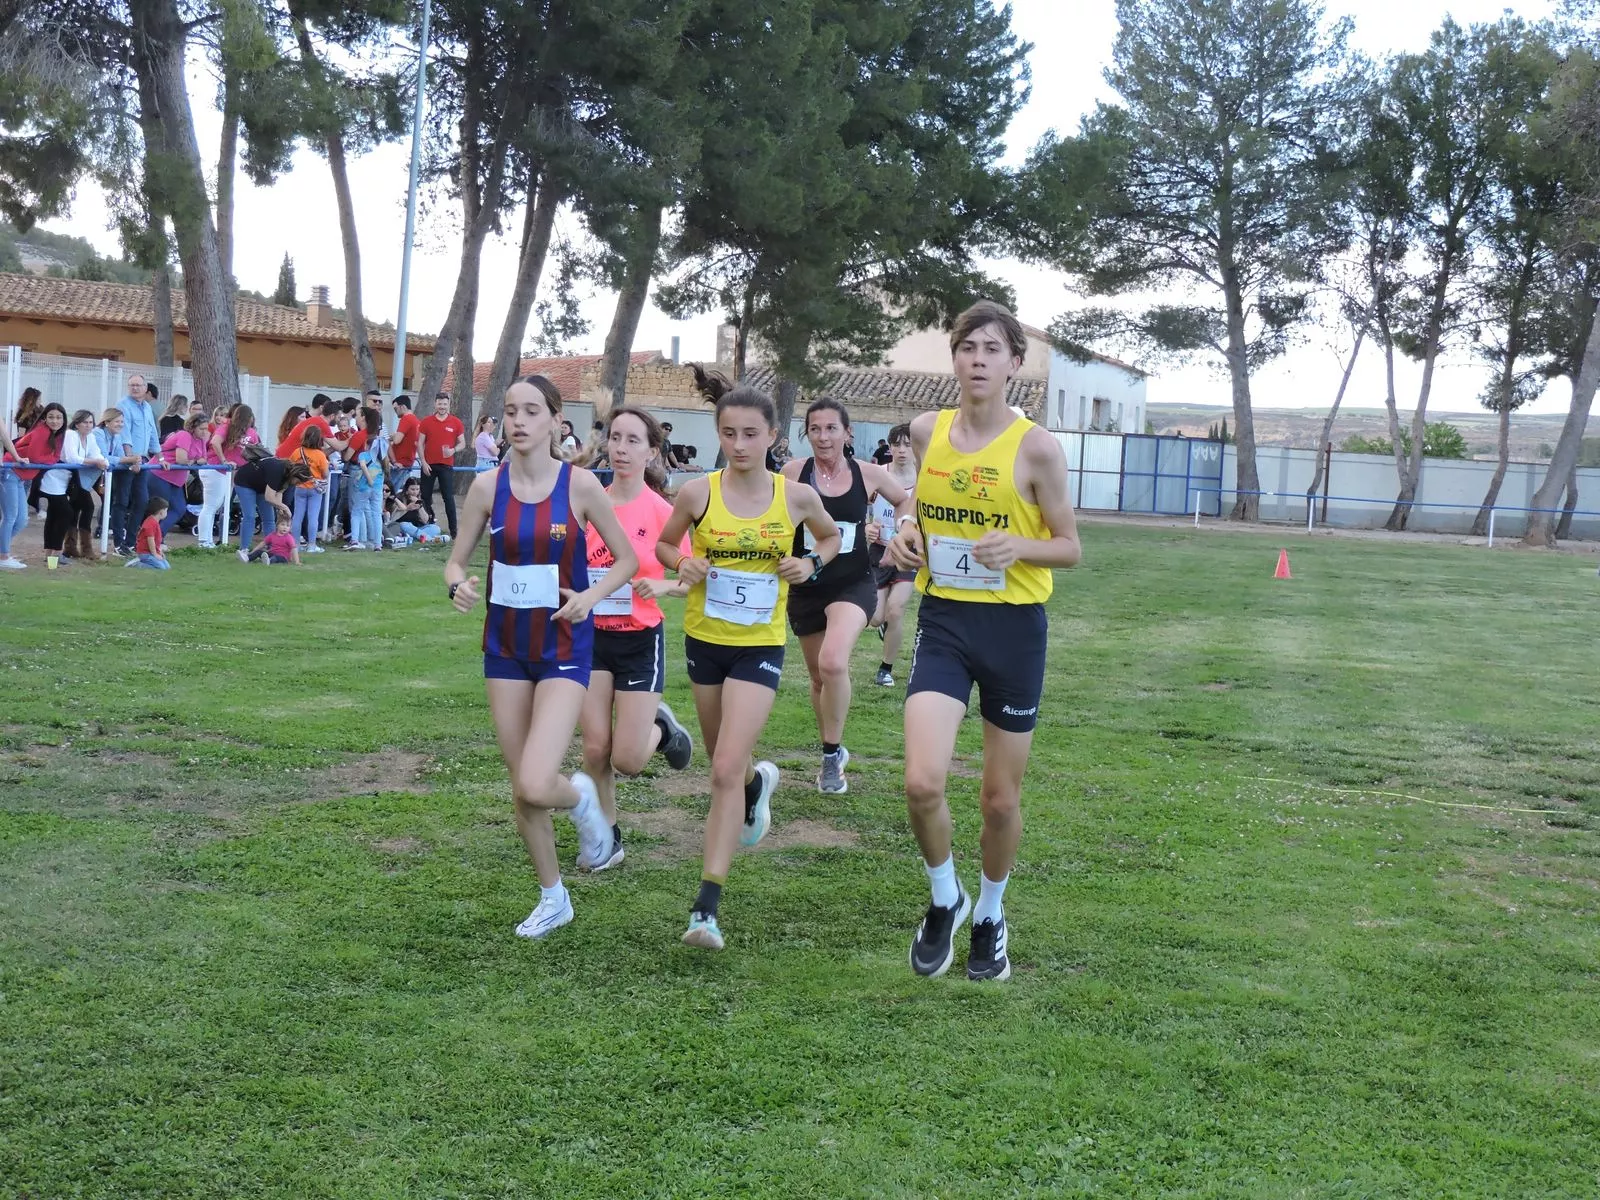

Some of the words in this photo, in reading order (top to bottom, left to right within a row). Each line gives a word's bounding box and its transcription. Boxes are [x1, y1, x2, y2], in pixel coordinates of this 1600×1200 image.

[922, 502, 1009, 529] SCORPIO-71
[955, 553, 971, 575] 4
[511, 582, 527, 594] 07
[734, 585, 747, 605] 5
